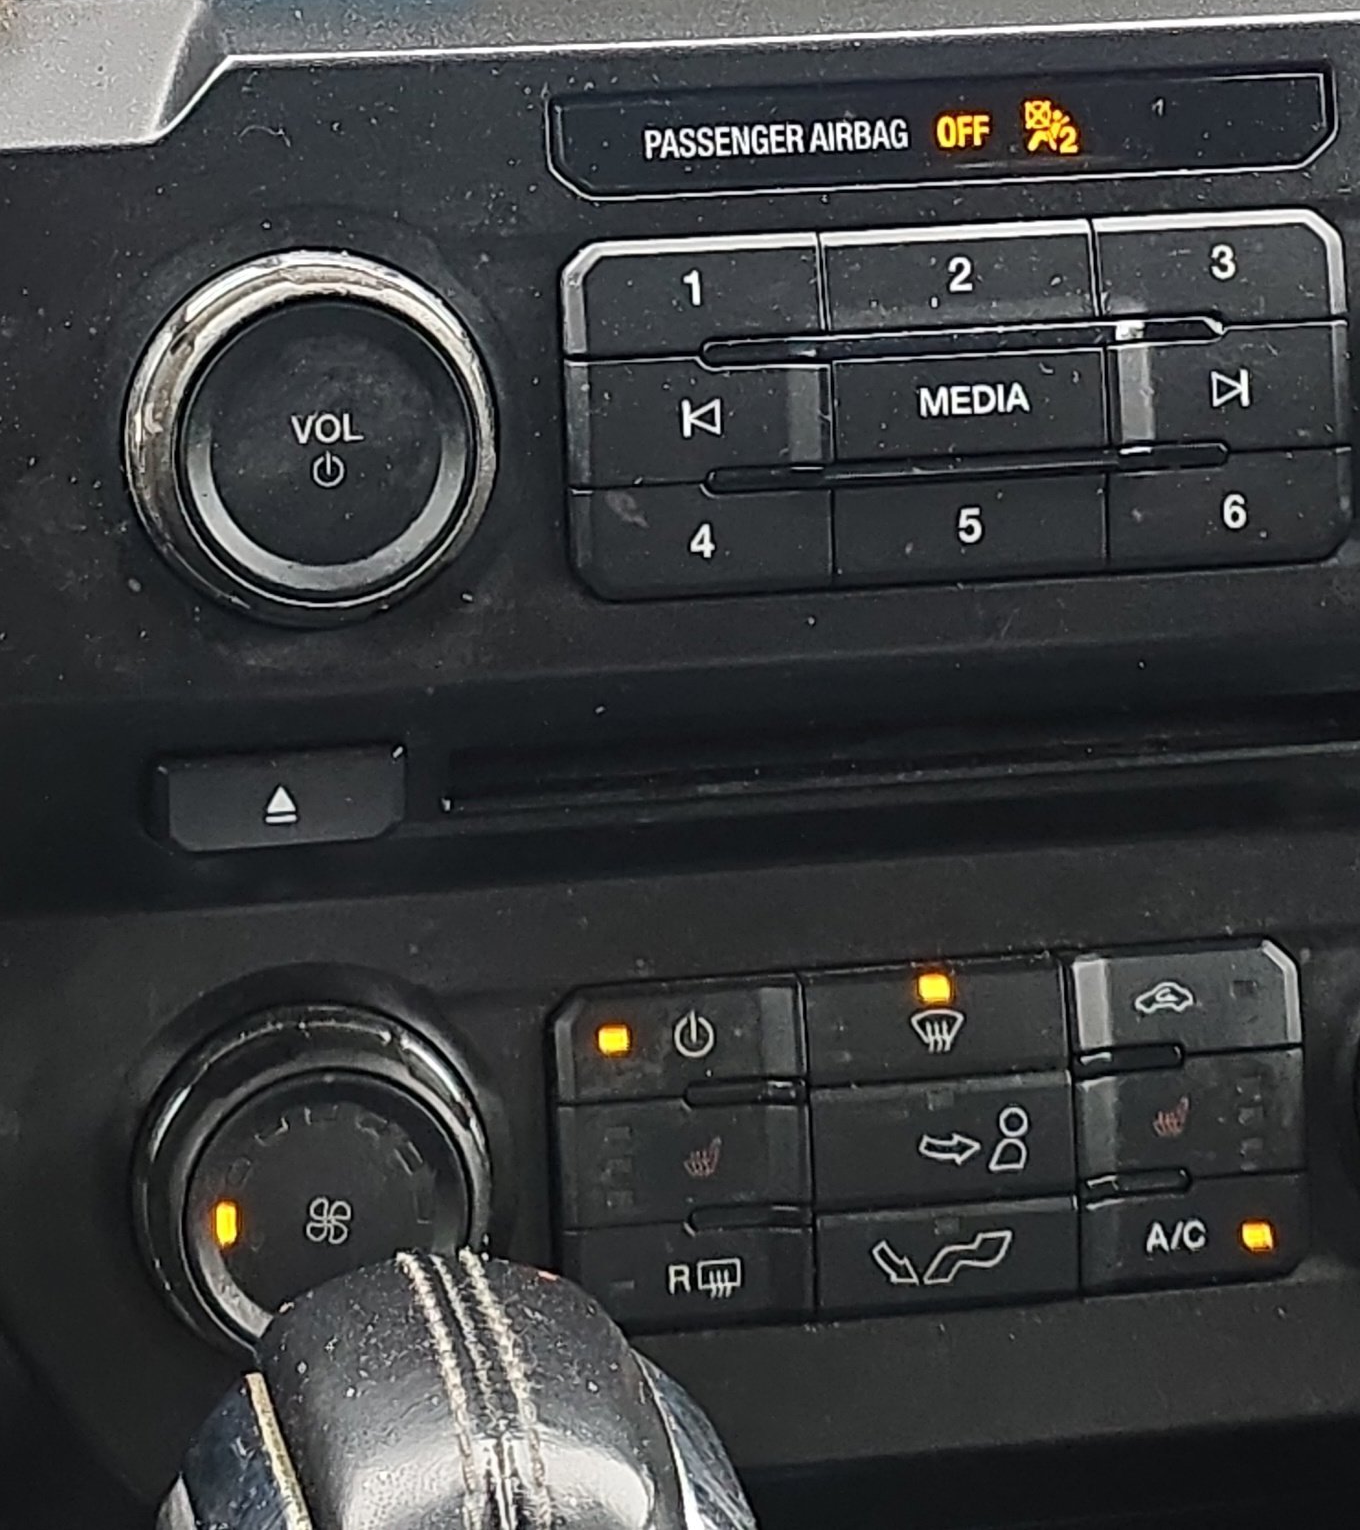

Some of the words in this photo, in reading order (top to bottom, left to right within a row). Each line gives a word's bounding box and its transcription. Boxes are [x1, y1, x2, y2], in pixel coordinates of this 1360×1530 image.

[644, 123, 805, 159] PASSENGER
[809, 118, 909, 153] AIRBAG
[936, 114, 990, 148] OFF
[948, 256, 973, 292] 2
[1211, 244, 1236, 280] 3
[683, 270, 701, 306] 1
[920, 382, 1030, 417] MEDIA
[291, 412, 364, 444] VOL
[958, 507, 982, 543] 5
[1223, 494, 1247, 529] 6
[690, 523, 715, 558] 4
[1146, 1219, 1206, 1253] A/C
[667, 1264, 692, 1295] R
